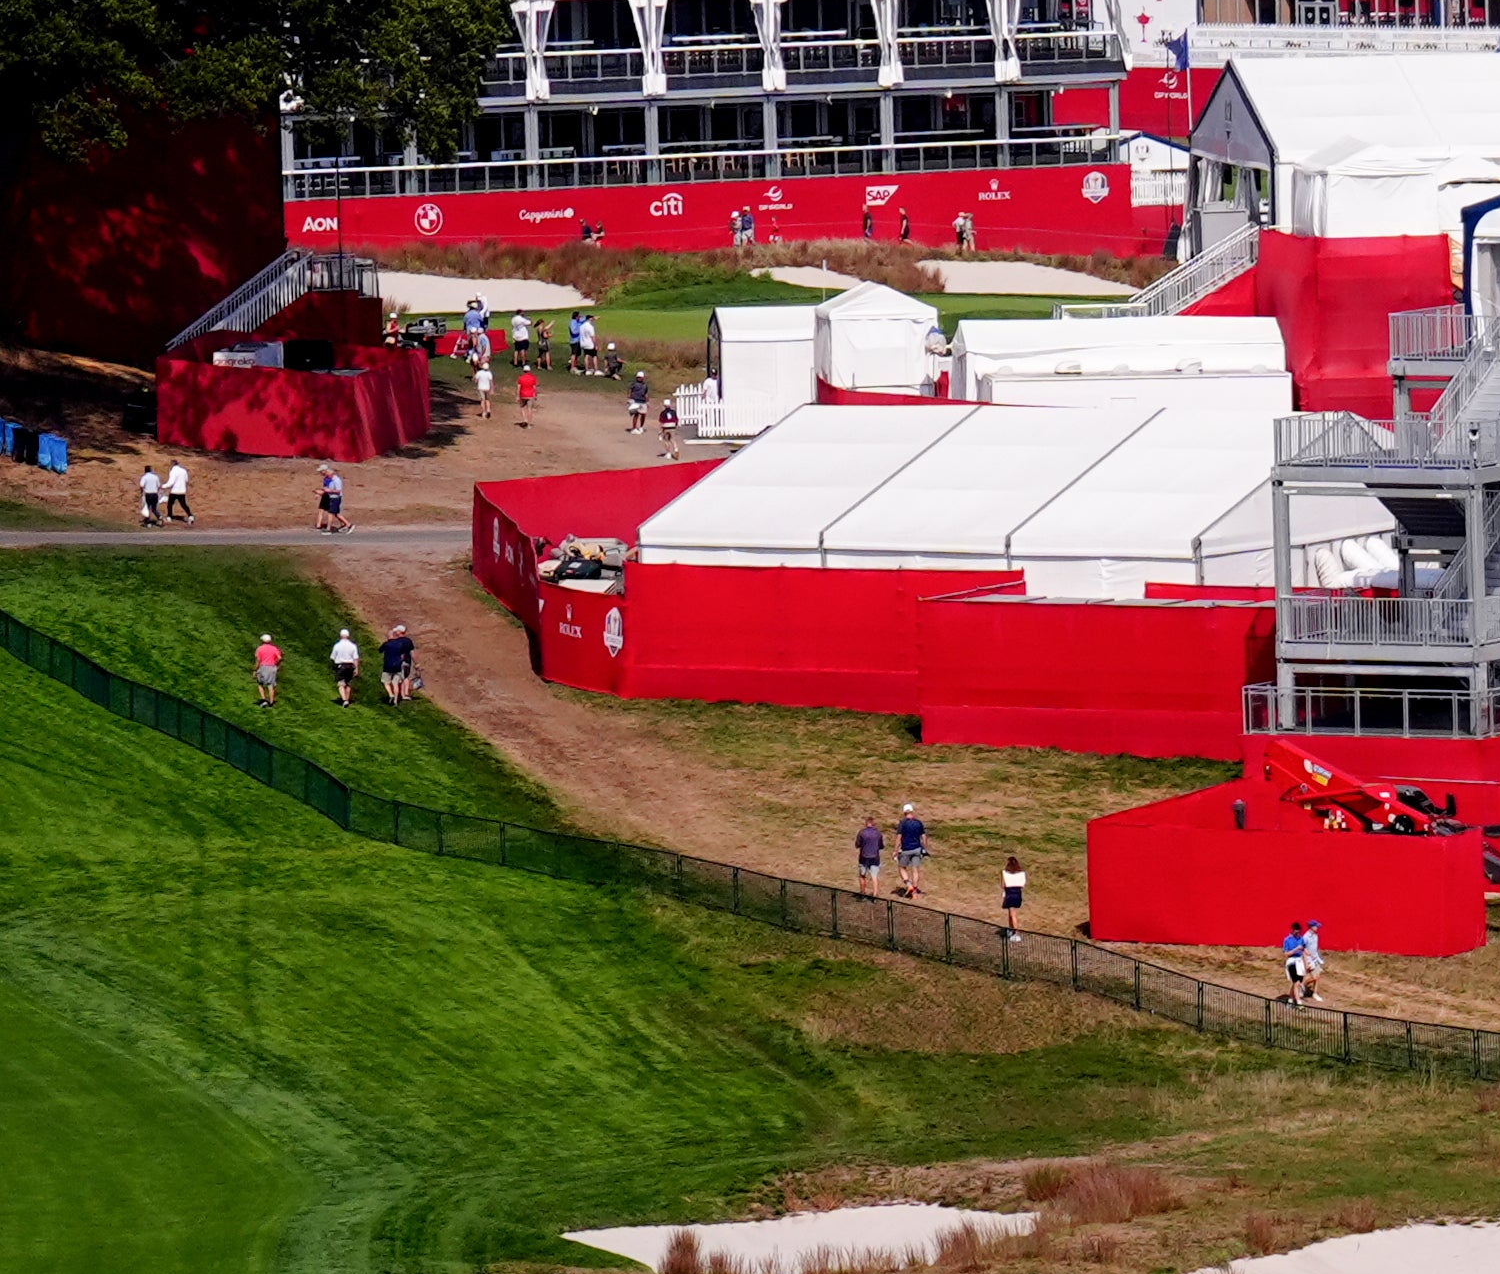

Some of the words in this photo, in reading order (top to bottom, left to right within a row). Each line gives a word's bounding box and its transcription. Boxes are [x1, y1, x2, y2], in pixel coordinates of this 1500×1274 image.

[867, 189, 890, 201] SAP
[978, 191, 1011, 201] ROLEX
[650, 192, 684, 217] citi
[518, 207, 565, 224] Capgemini
[559, 621, 583, 639] ROLEX
